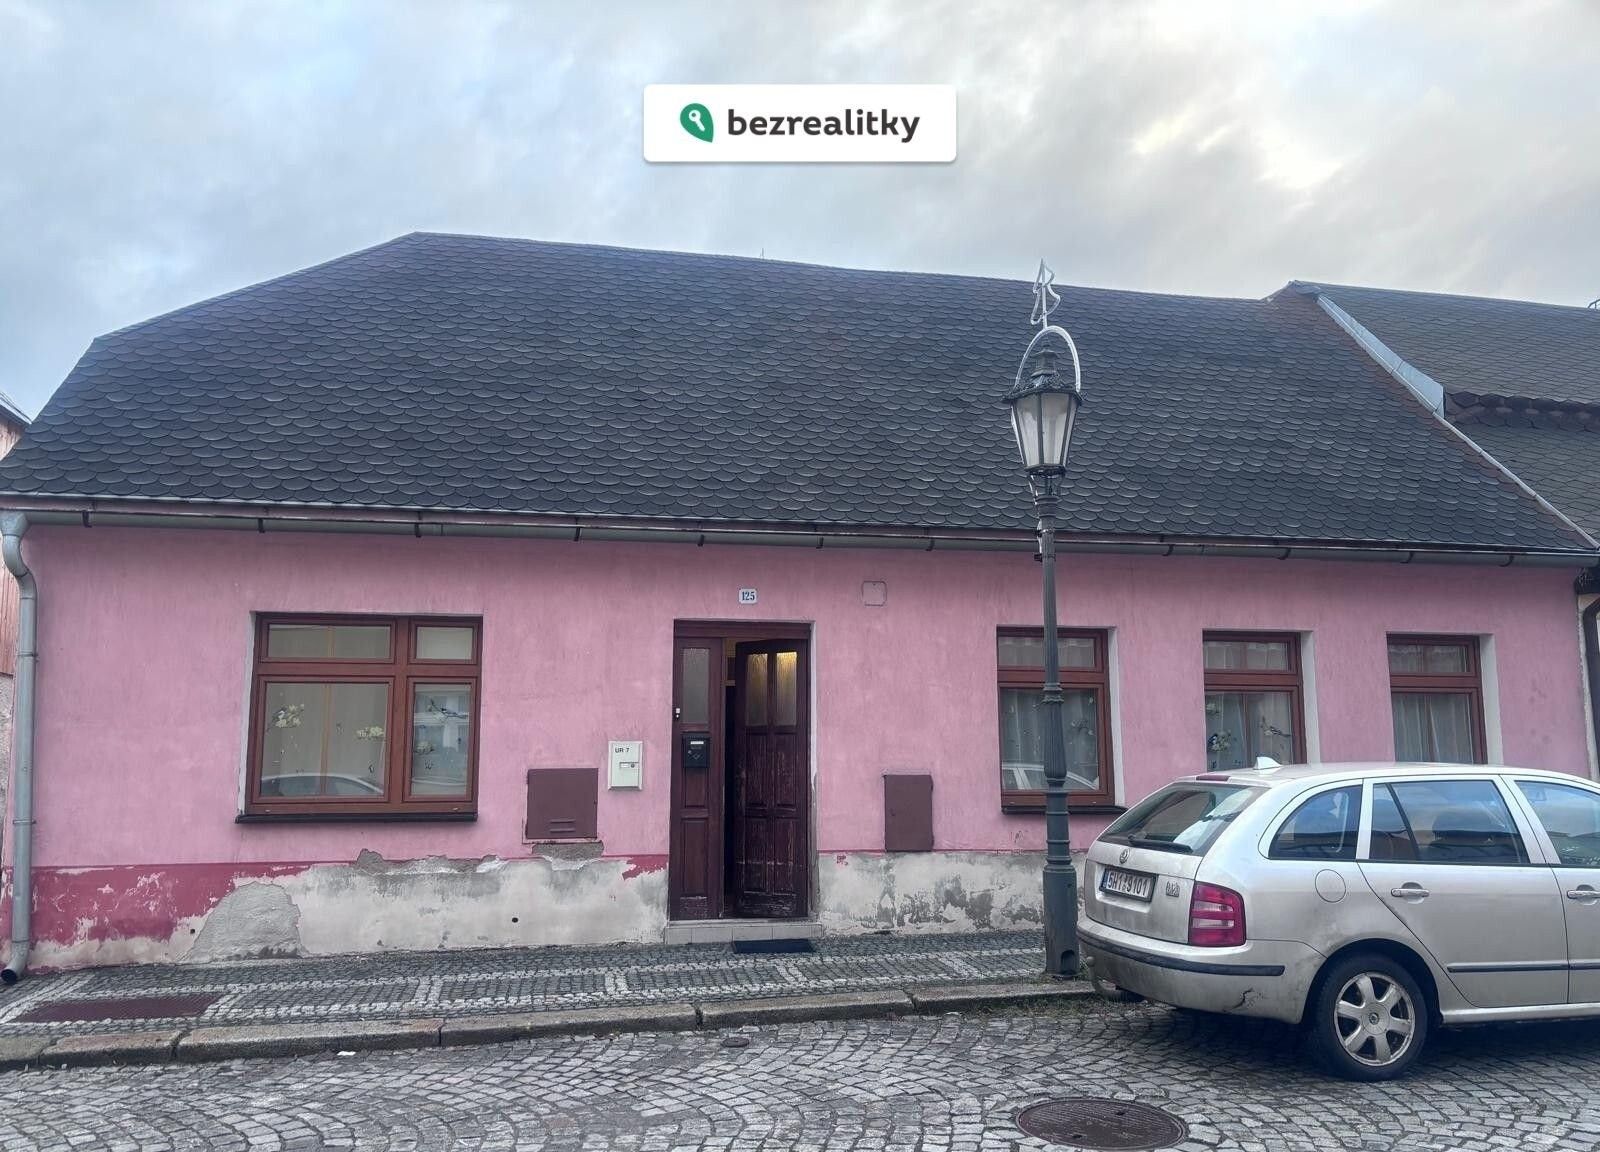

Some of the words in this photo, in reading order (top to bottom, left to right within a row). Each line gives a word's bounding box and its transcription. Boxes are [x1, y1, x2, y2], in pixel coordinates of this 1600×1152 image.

[742, 591, 755, 601] 125
[1108, 871, 1122, 889] 5H1
[1127, 877, 1148, 896] 9101
